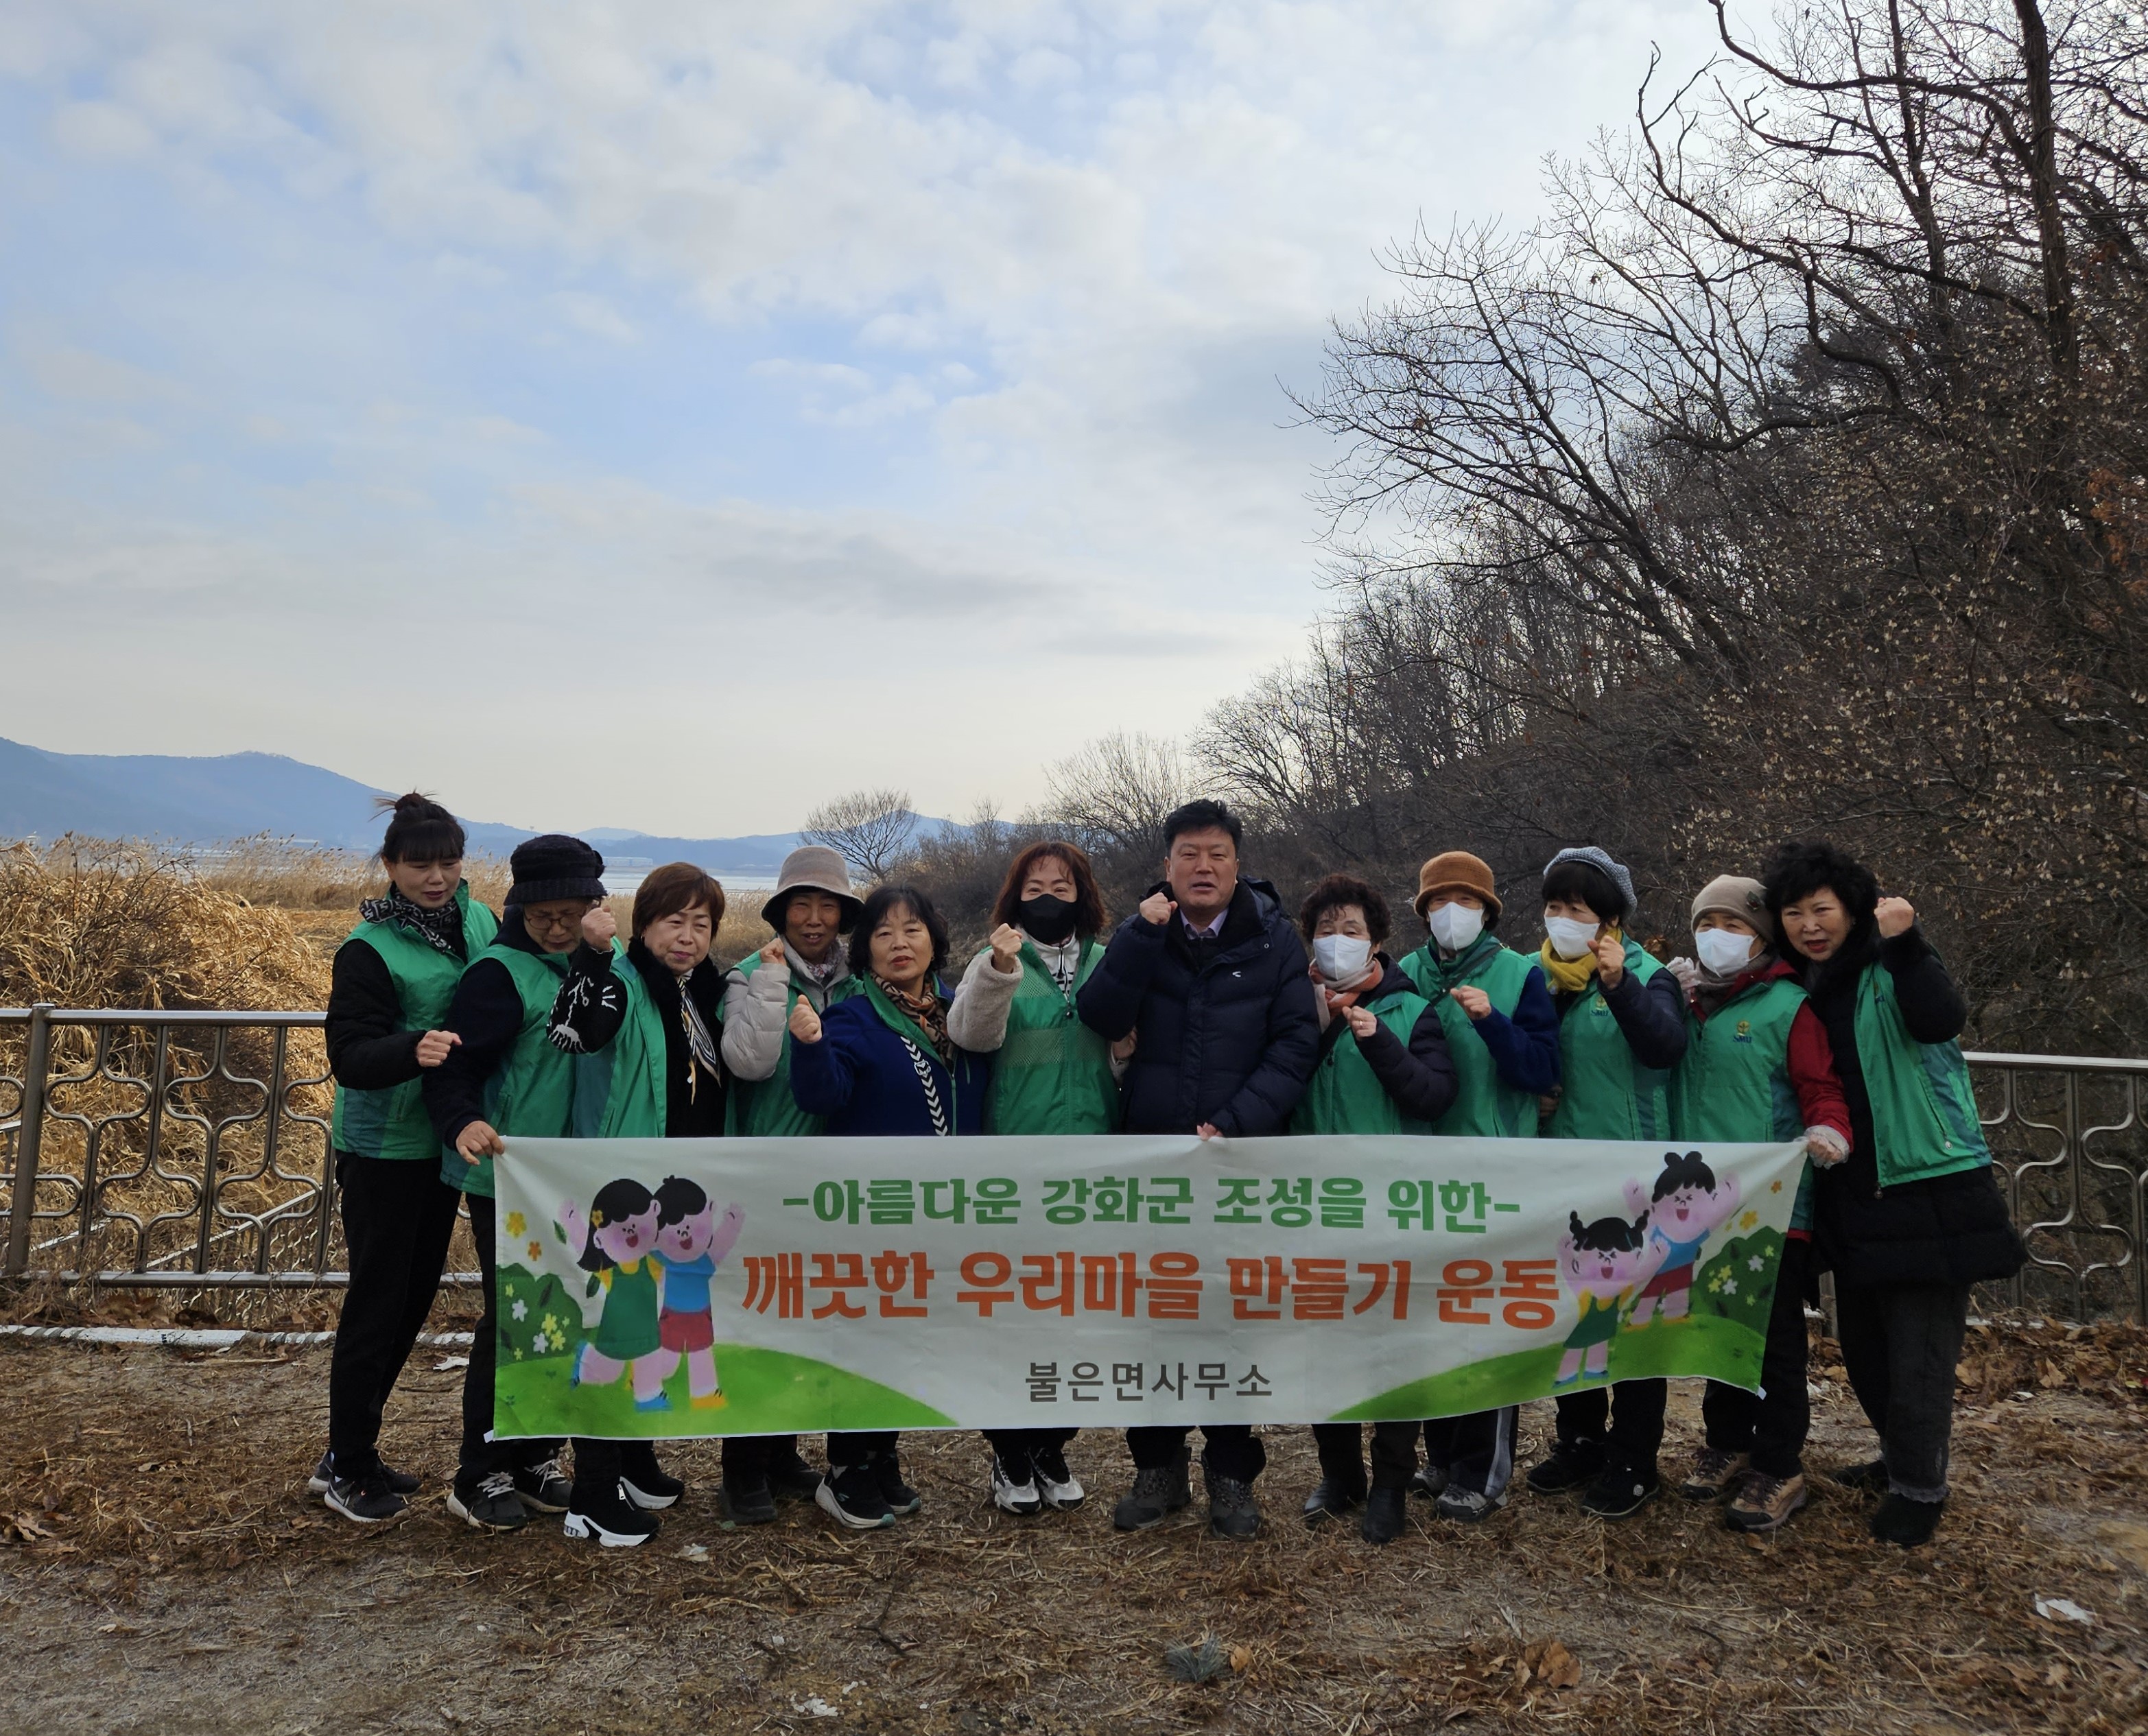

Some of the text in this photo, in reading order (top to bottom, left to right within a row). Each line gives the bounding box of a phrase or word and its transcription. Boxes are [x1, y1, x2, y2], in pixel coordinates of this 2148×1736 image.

[1041, 1176, 1194, 1225] 강화군
[1214, 1177, 1367, 1228] 조성을
[742, 1250, 1559, 1330] 깨끗한 우리마을 만들기 운동
[1025, 1361, 1273, 1403] 불은면사무소
